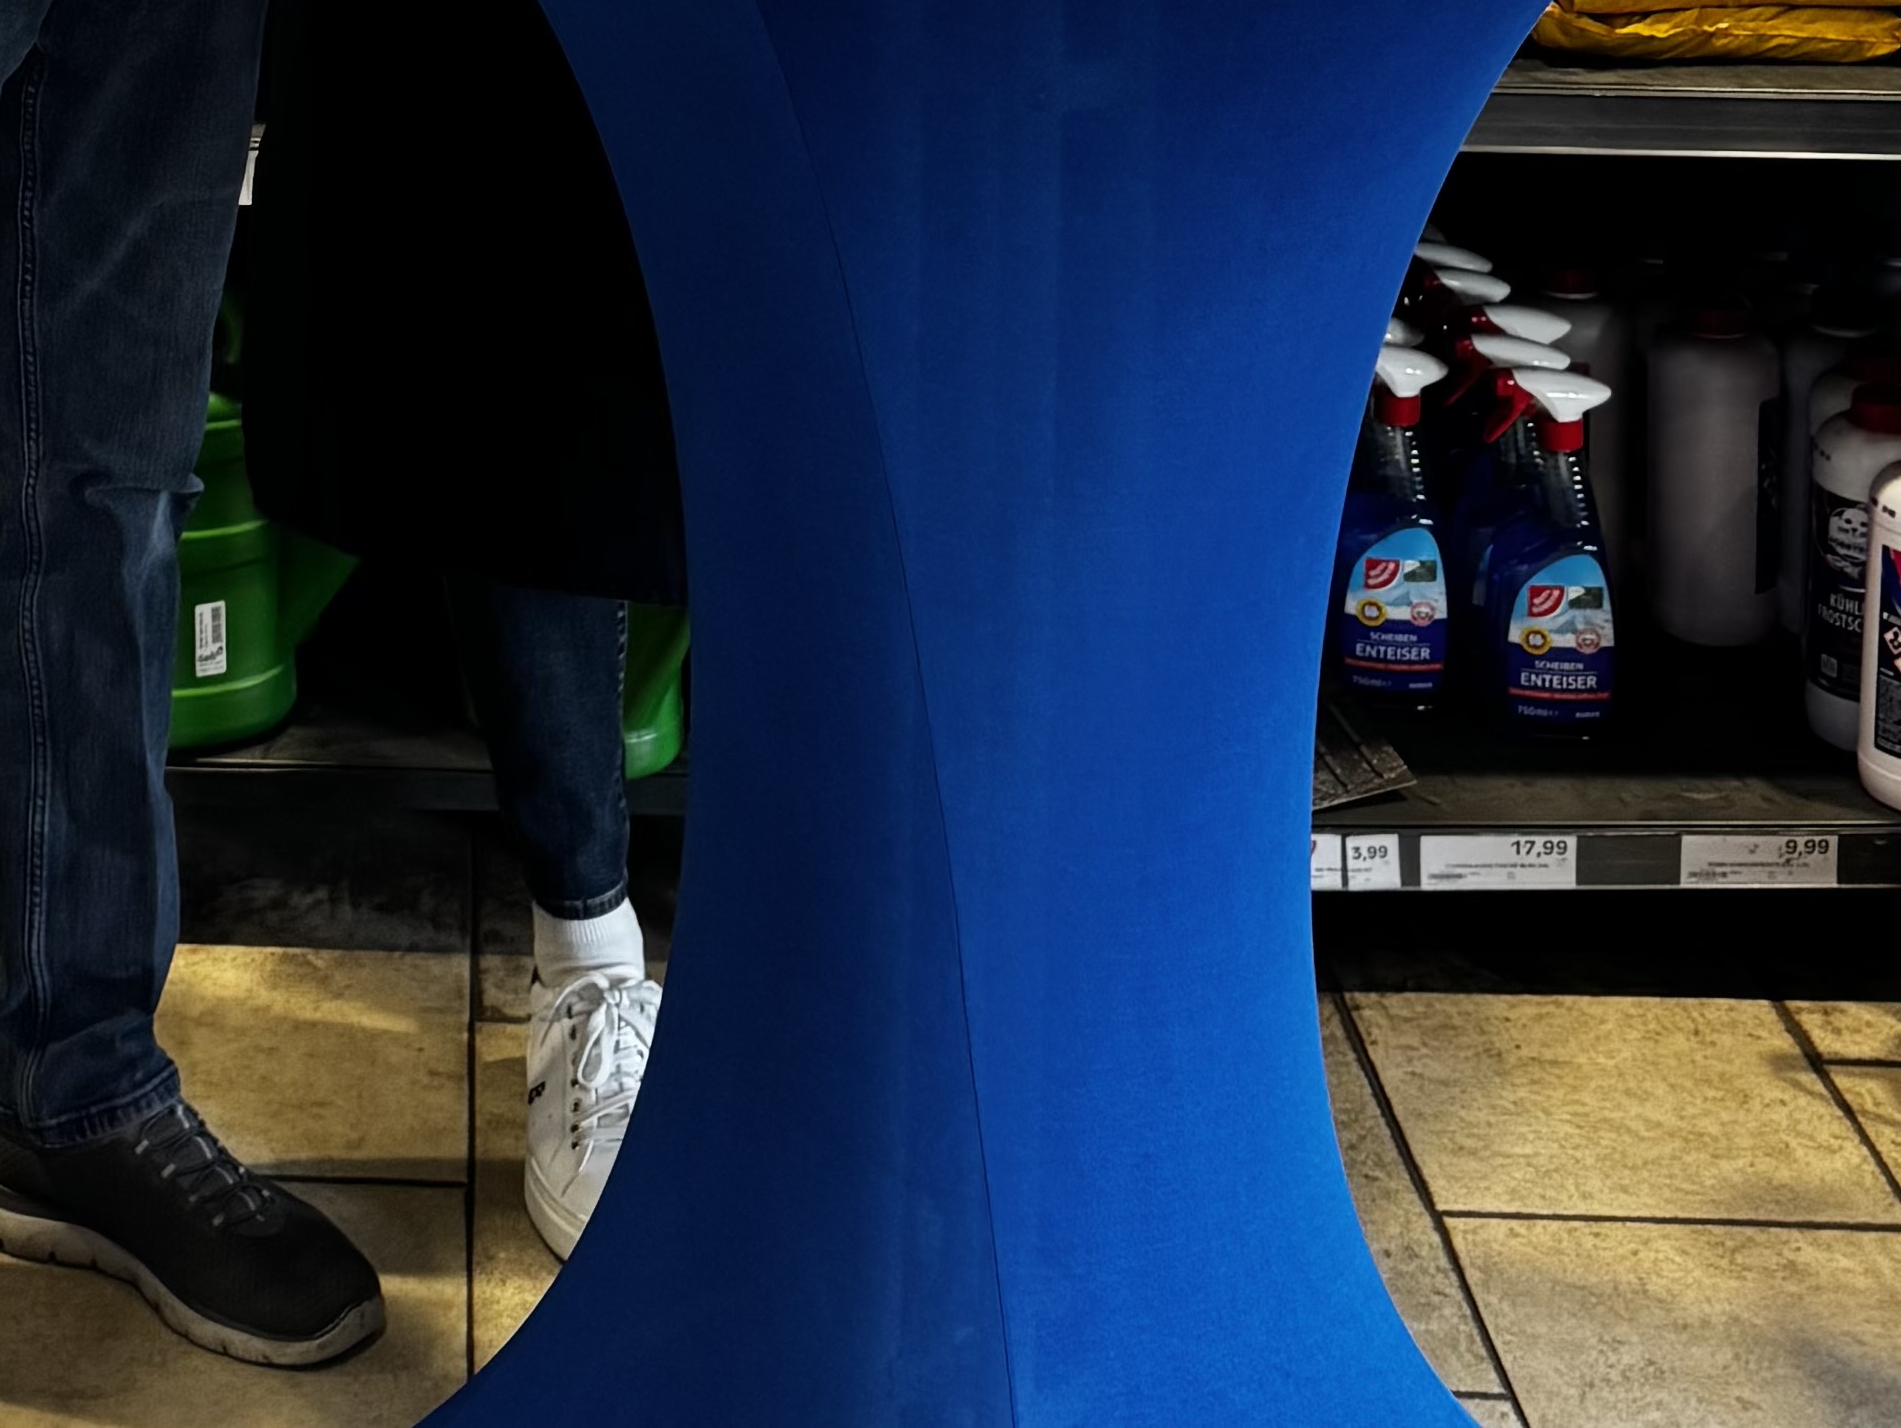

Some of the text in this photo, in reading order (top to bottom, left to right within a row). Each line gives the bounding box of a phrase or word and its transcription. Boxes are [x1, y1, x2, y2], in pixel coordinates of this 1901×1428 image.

[1829, 592, 1865, 616] KÜHL
[1818, 603, 1862, 633] FROSTSC
[1355, 643, 1430, 661] ENTEISER
[1520, 672, 1597, 689] ENTEISER
[1351, 845, 1388, 862] 3,99
[1510, 840, 1567, 858] 17,99
[1785, 839, 1829, 856] 9,99
